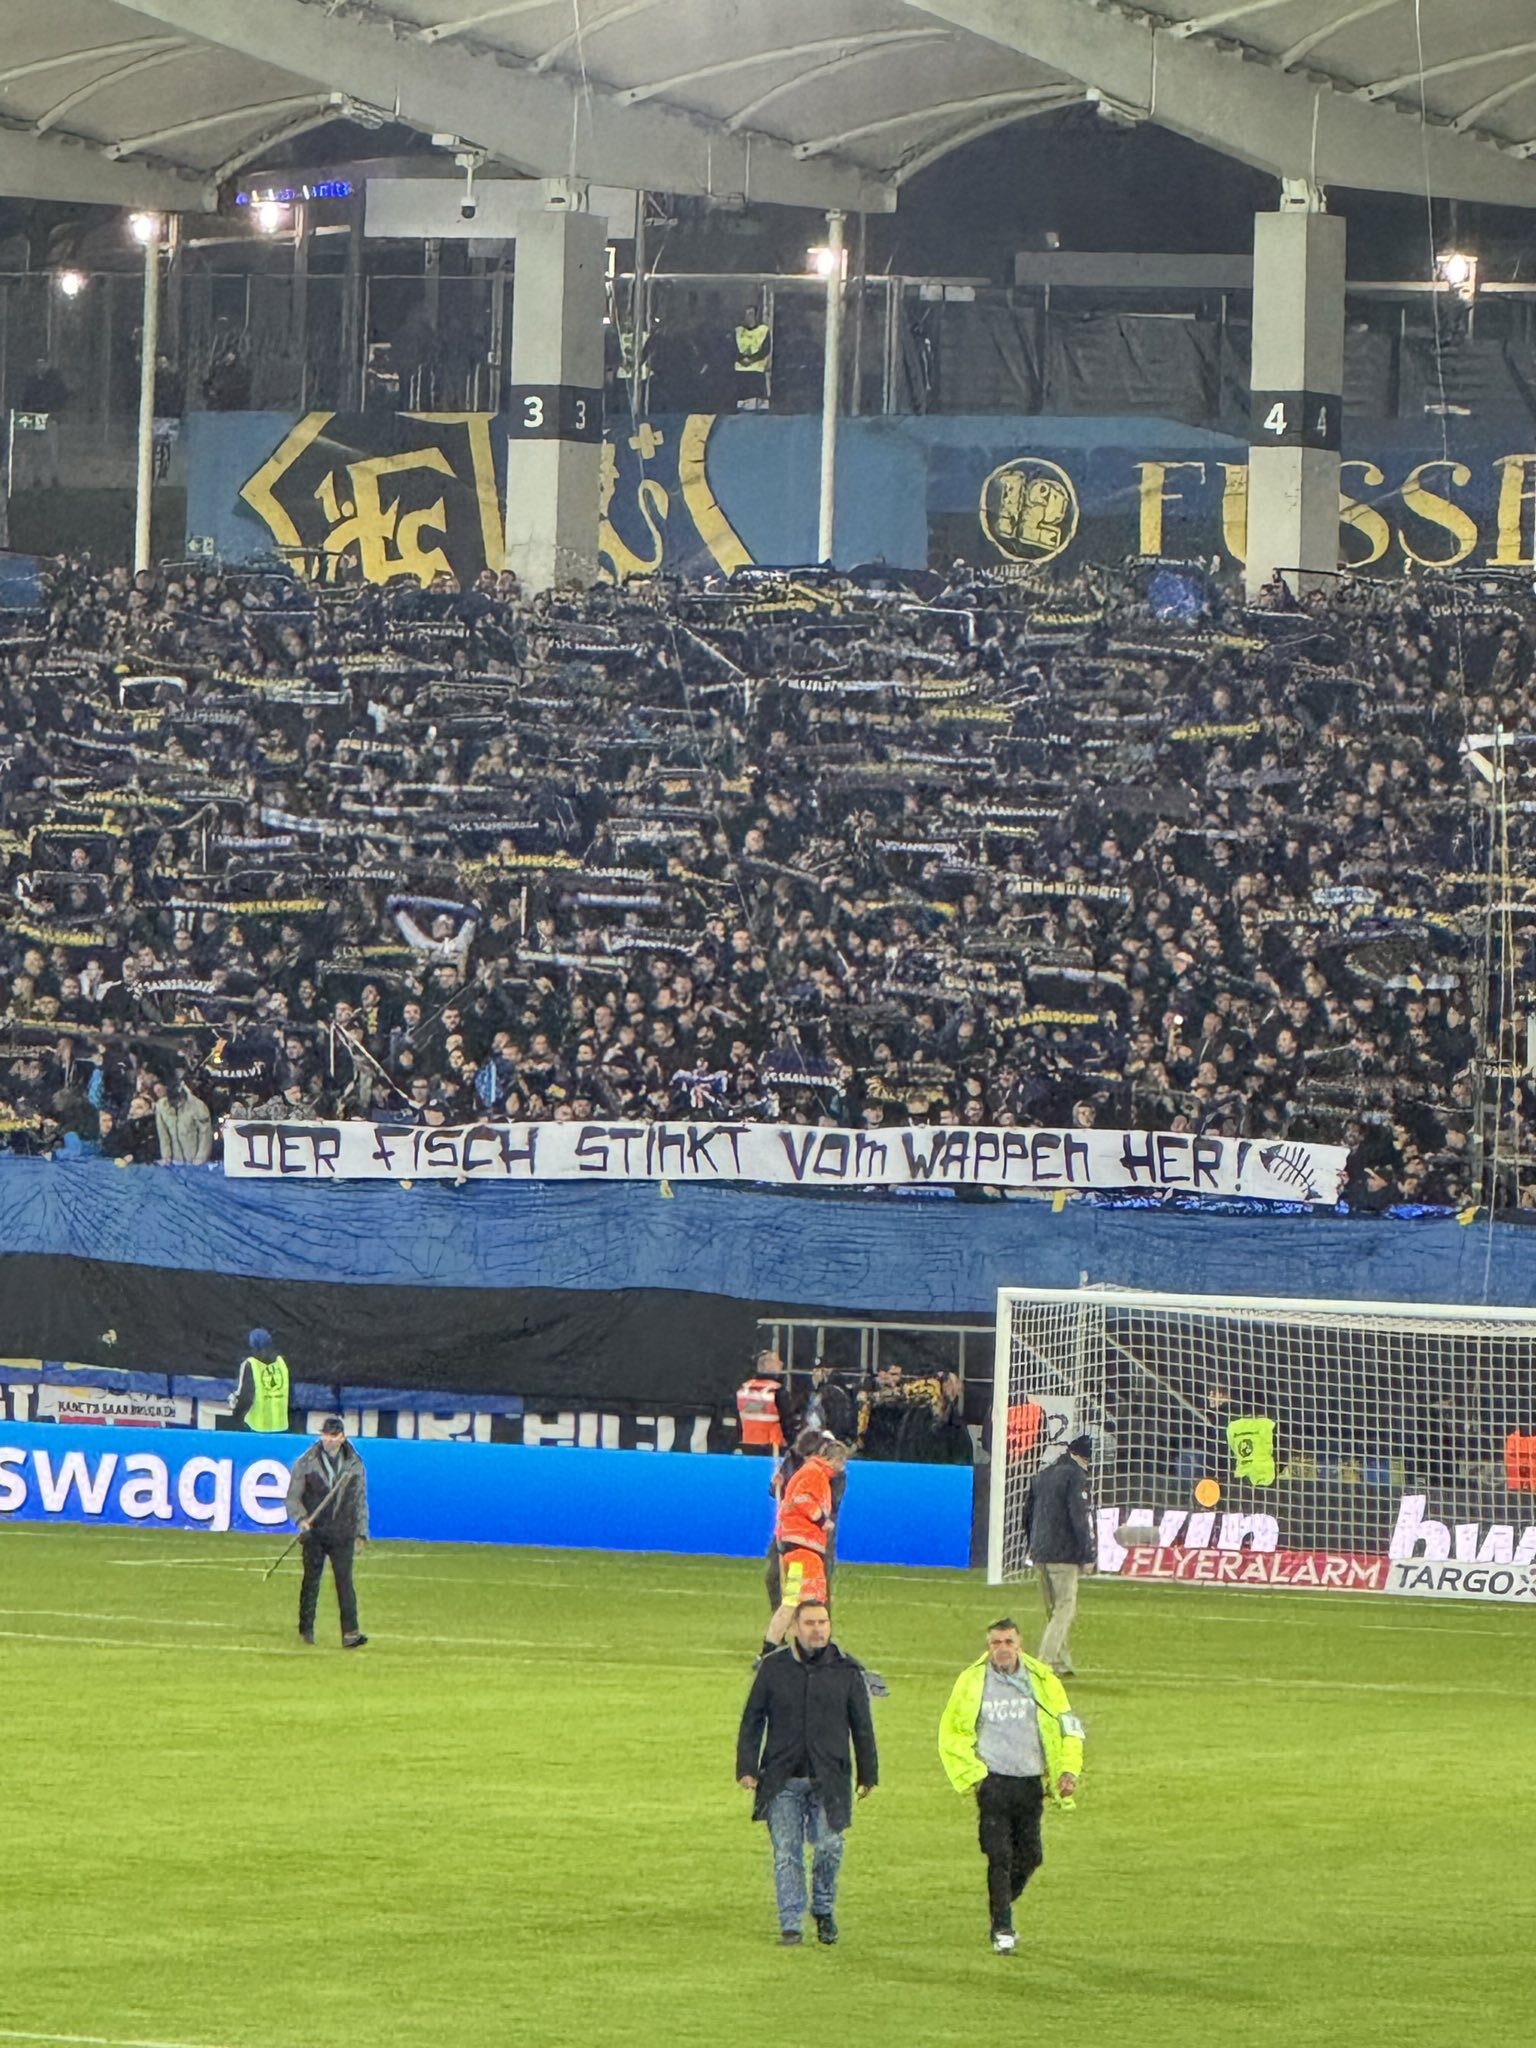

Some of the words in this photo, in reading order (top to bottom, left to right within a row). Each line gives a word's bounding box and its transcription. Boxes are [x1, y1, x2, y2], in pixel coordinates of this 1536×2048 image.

[523, 395, 544, 428] 3
[575, 400, 586, 430] 3
[1263, 402, 1288, 435] 4
[1316, 406, 1327, 437] 4
[235, 1124, 341, 1175] DER
[373, 1125, 539, 1175] FISCH
[1120, 1132, 1252, 1192] HER!
[1131, 1548, 1381, 1589] FLYERALARM
[1395, 1563, 1514, 1595] TARGO
